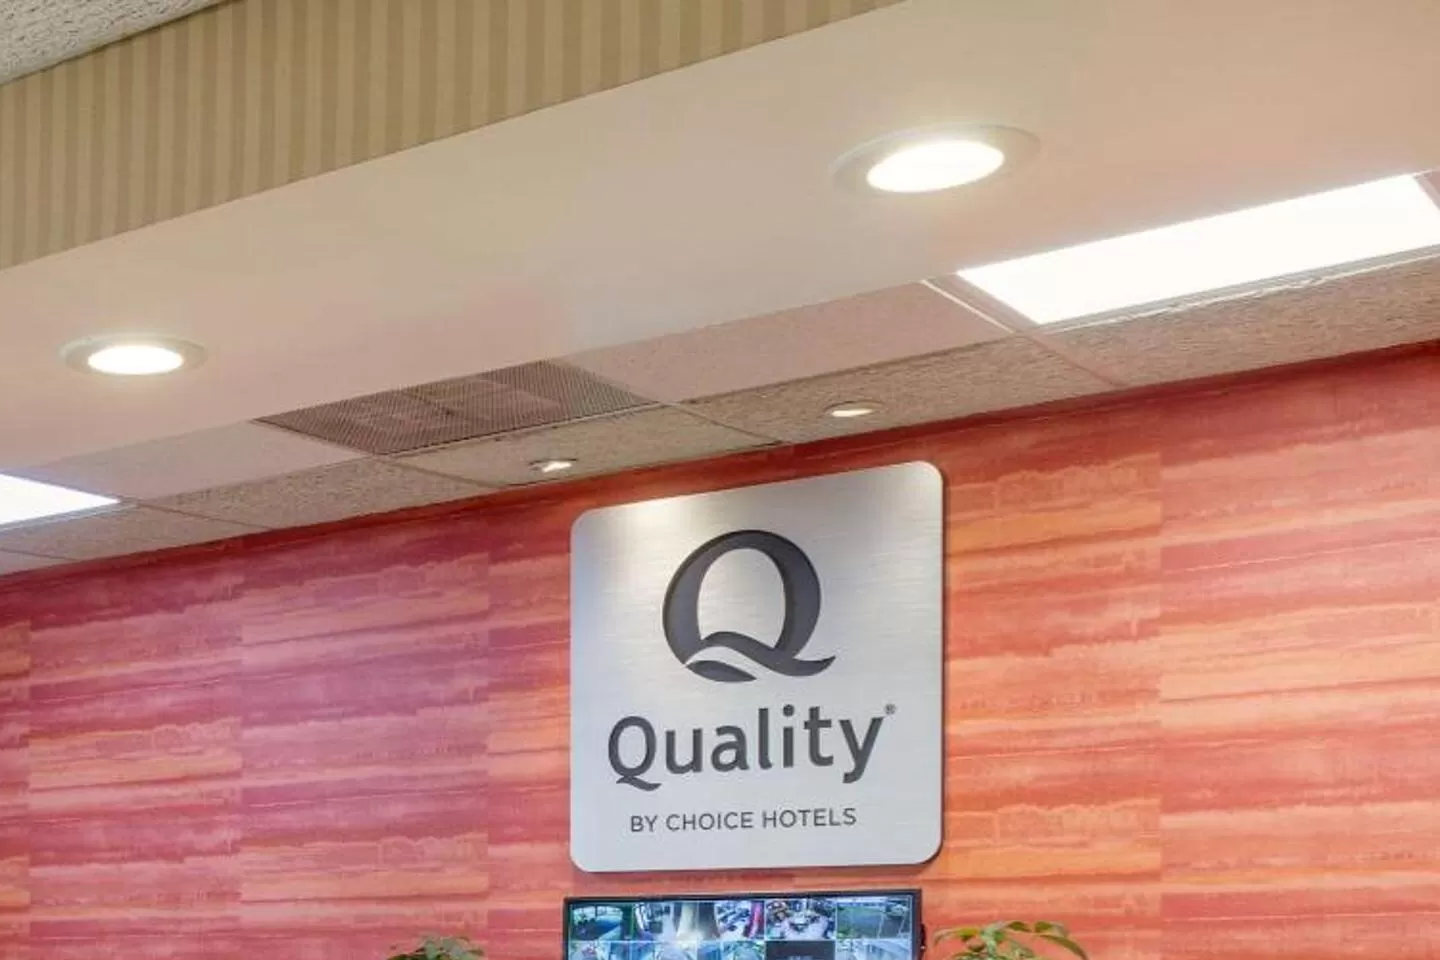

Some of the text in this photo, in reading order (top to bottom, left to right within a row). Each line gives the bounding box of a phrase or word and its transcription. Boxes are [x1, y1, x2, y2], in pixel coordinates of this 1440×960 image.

[661, 528, 837, 684] Q
[630, 807, 857, 833] BY CHOICE HOTELS
